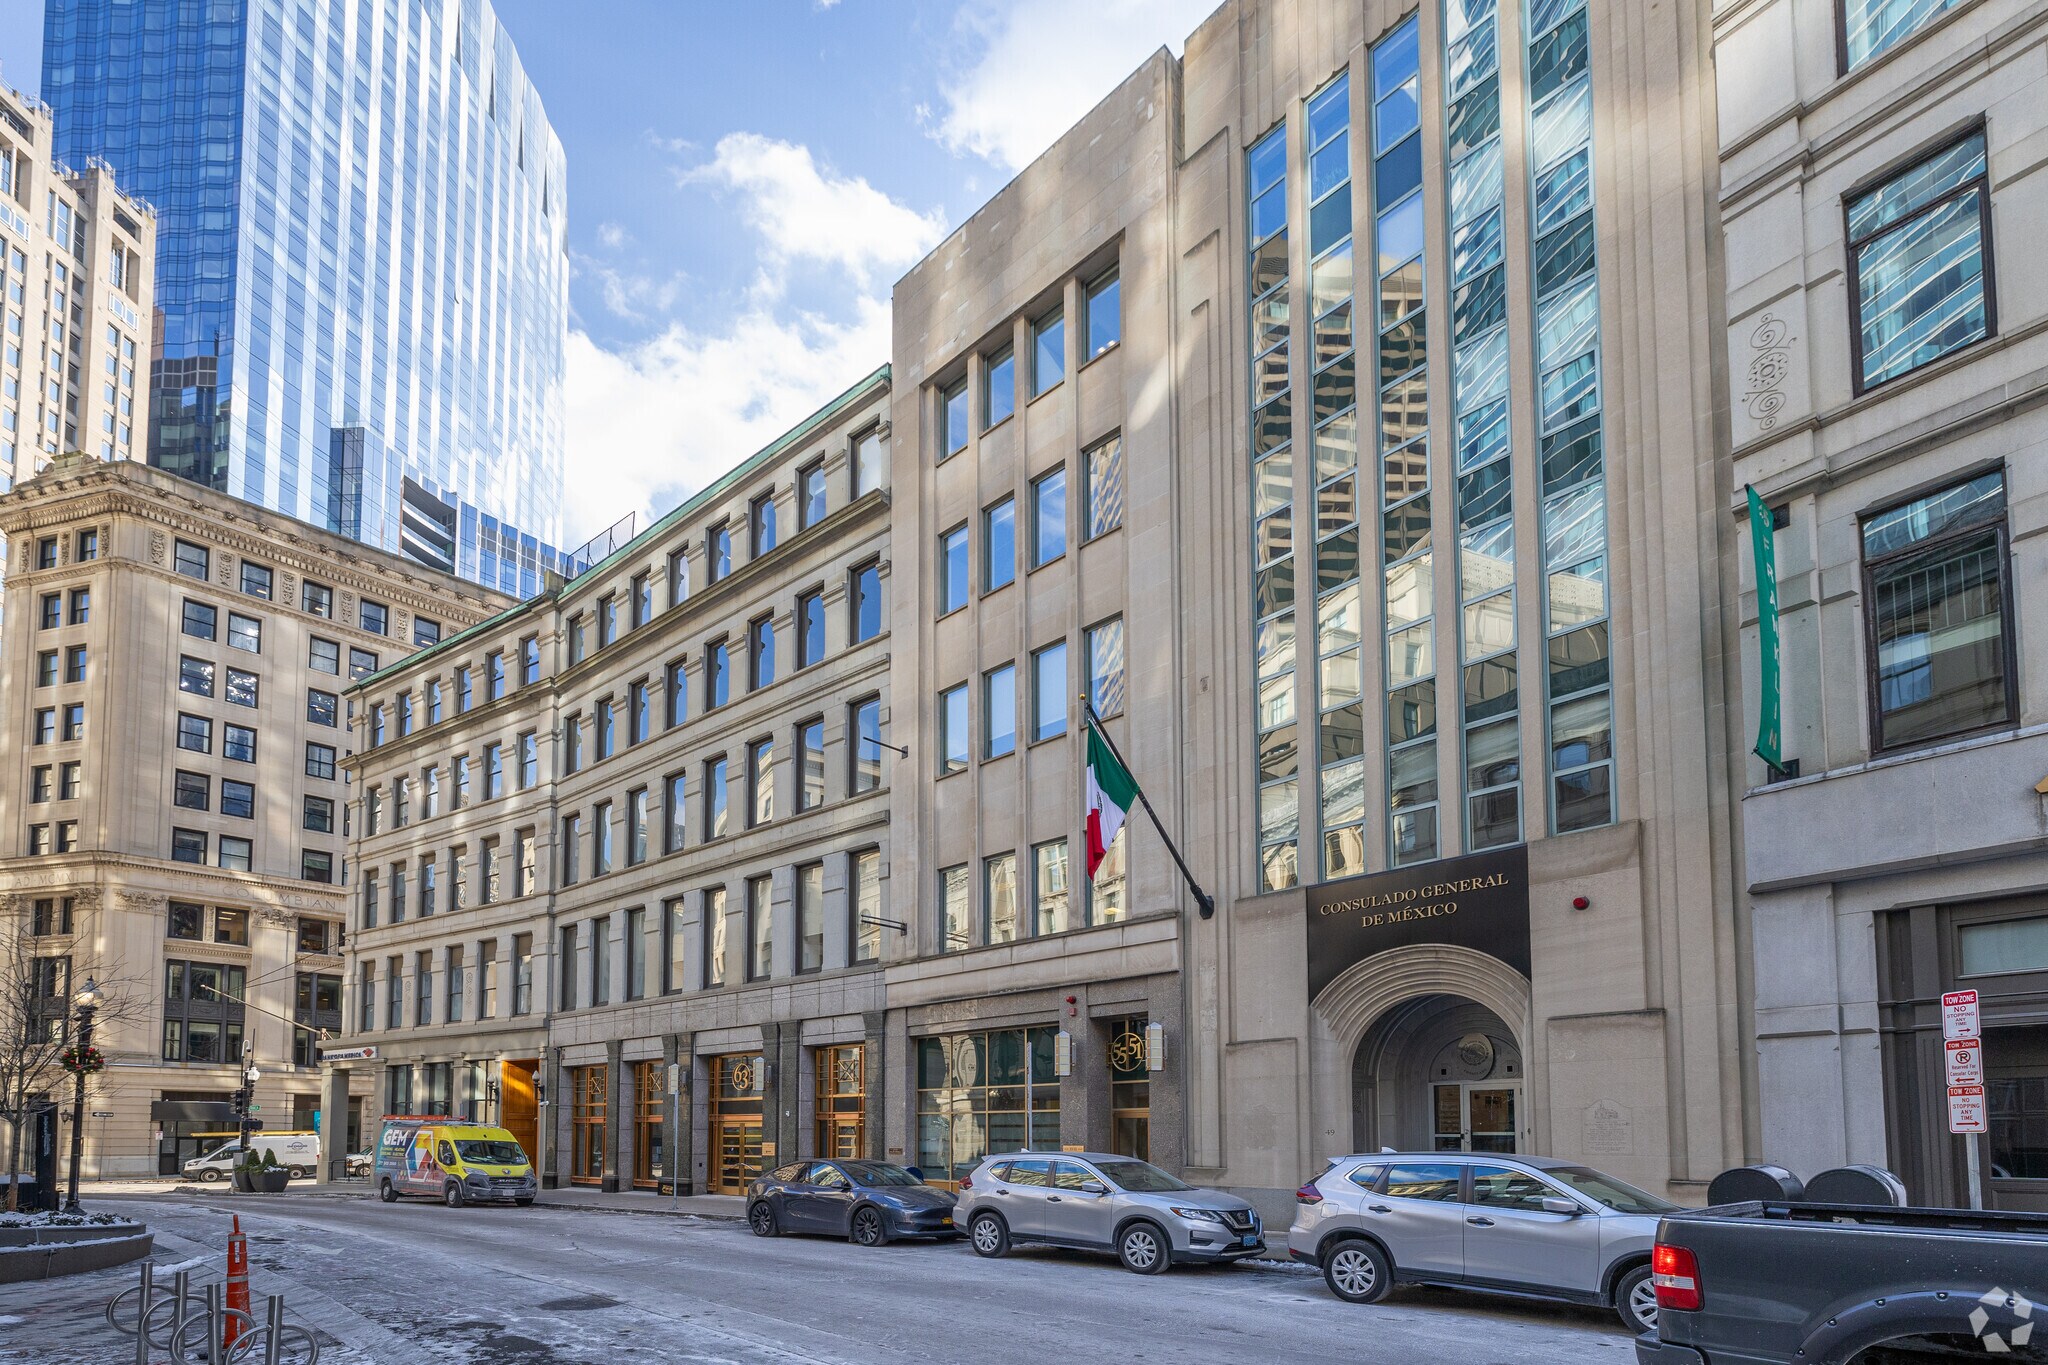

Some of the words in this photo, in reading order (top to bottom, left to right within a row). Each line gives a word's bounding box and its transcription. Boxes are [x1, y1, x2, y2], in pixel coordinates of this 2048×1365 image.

[166, 877, 205, 893] THE
[222, 885, 336, 911] COLUMBIAN
[1320, 888, 1417, 916] CONSULADO
[1421, 873, 1509, 899] GENERAL
[1361, 913, 1385, 928] DE
[1387, 902, 1458, 924] MÉXICO
[1959, 994, 1975, 1002] ZONE
[1953, 1005, 1967, 1013] NO
[383, 1129, 409, 1146] GEM
